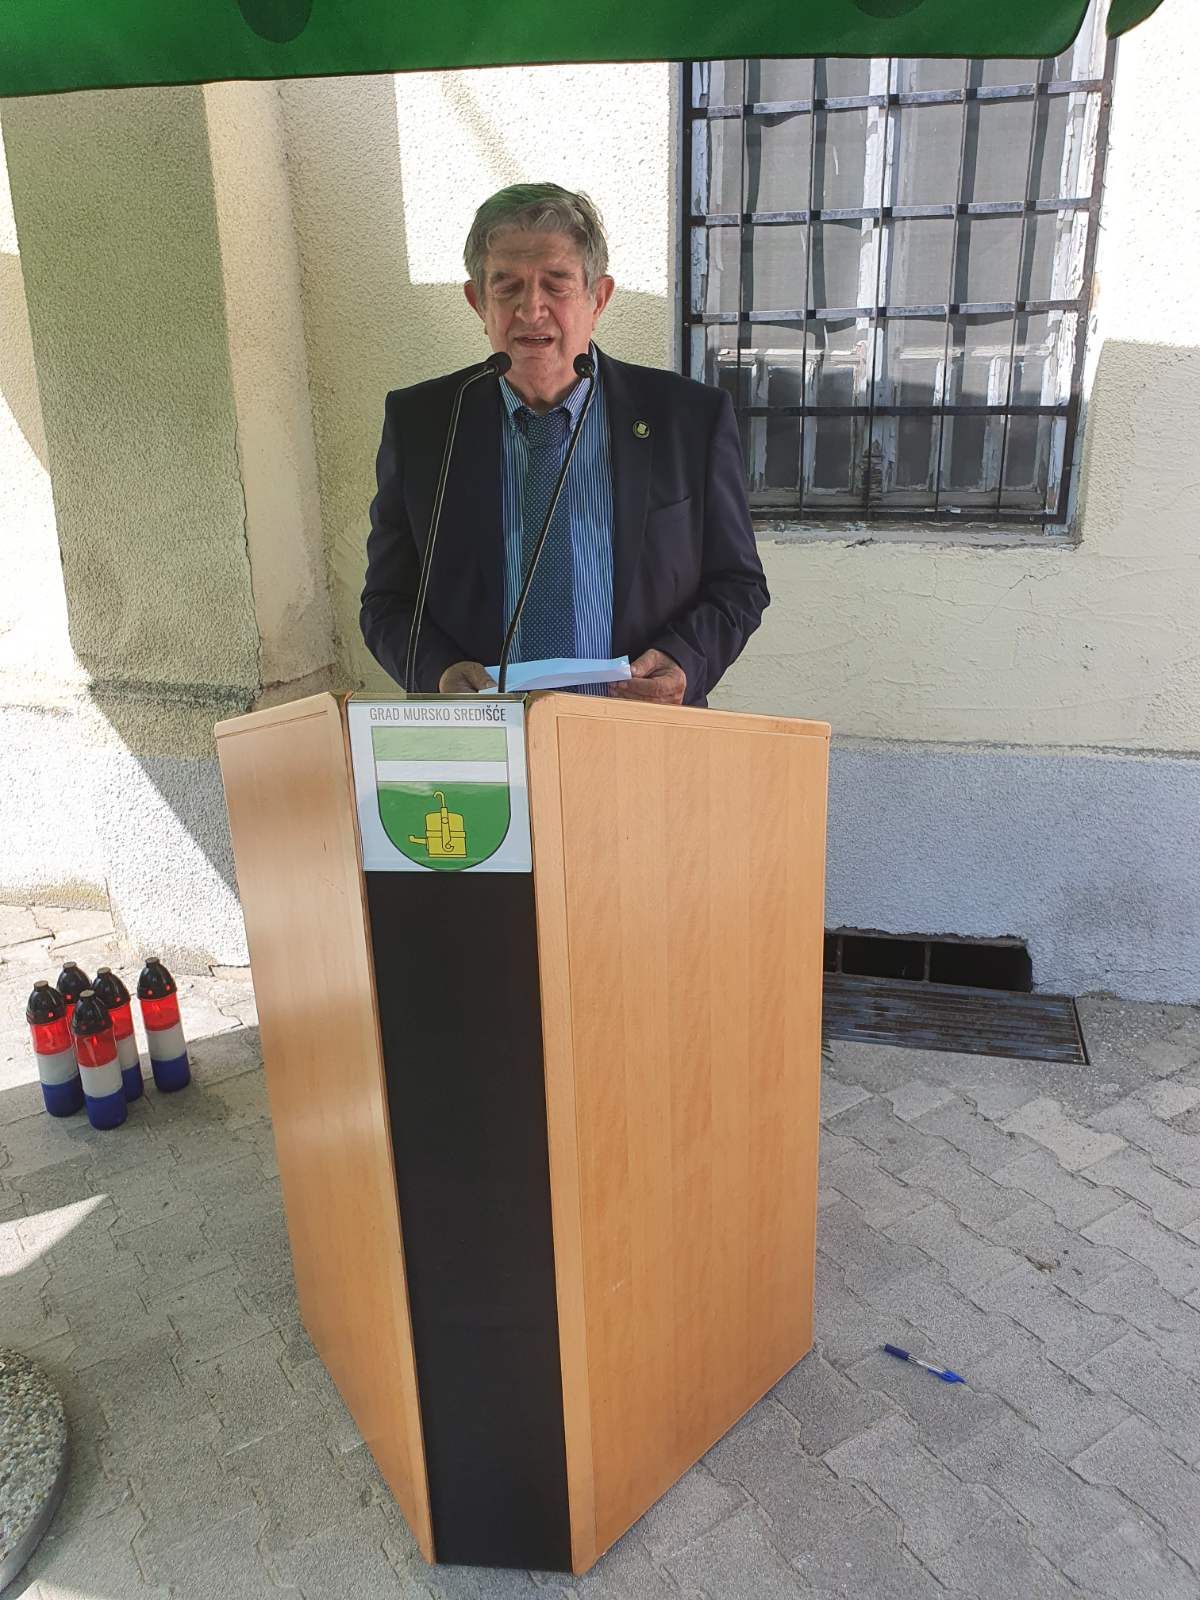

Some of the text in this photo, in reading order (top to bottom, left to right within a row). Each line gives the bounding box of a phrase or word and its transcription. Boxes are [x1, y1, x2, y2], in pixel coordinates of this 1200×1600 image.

[369, 704, 507, 722] GRAD MURSKO SREDIŠĆE
